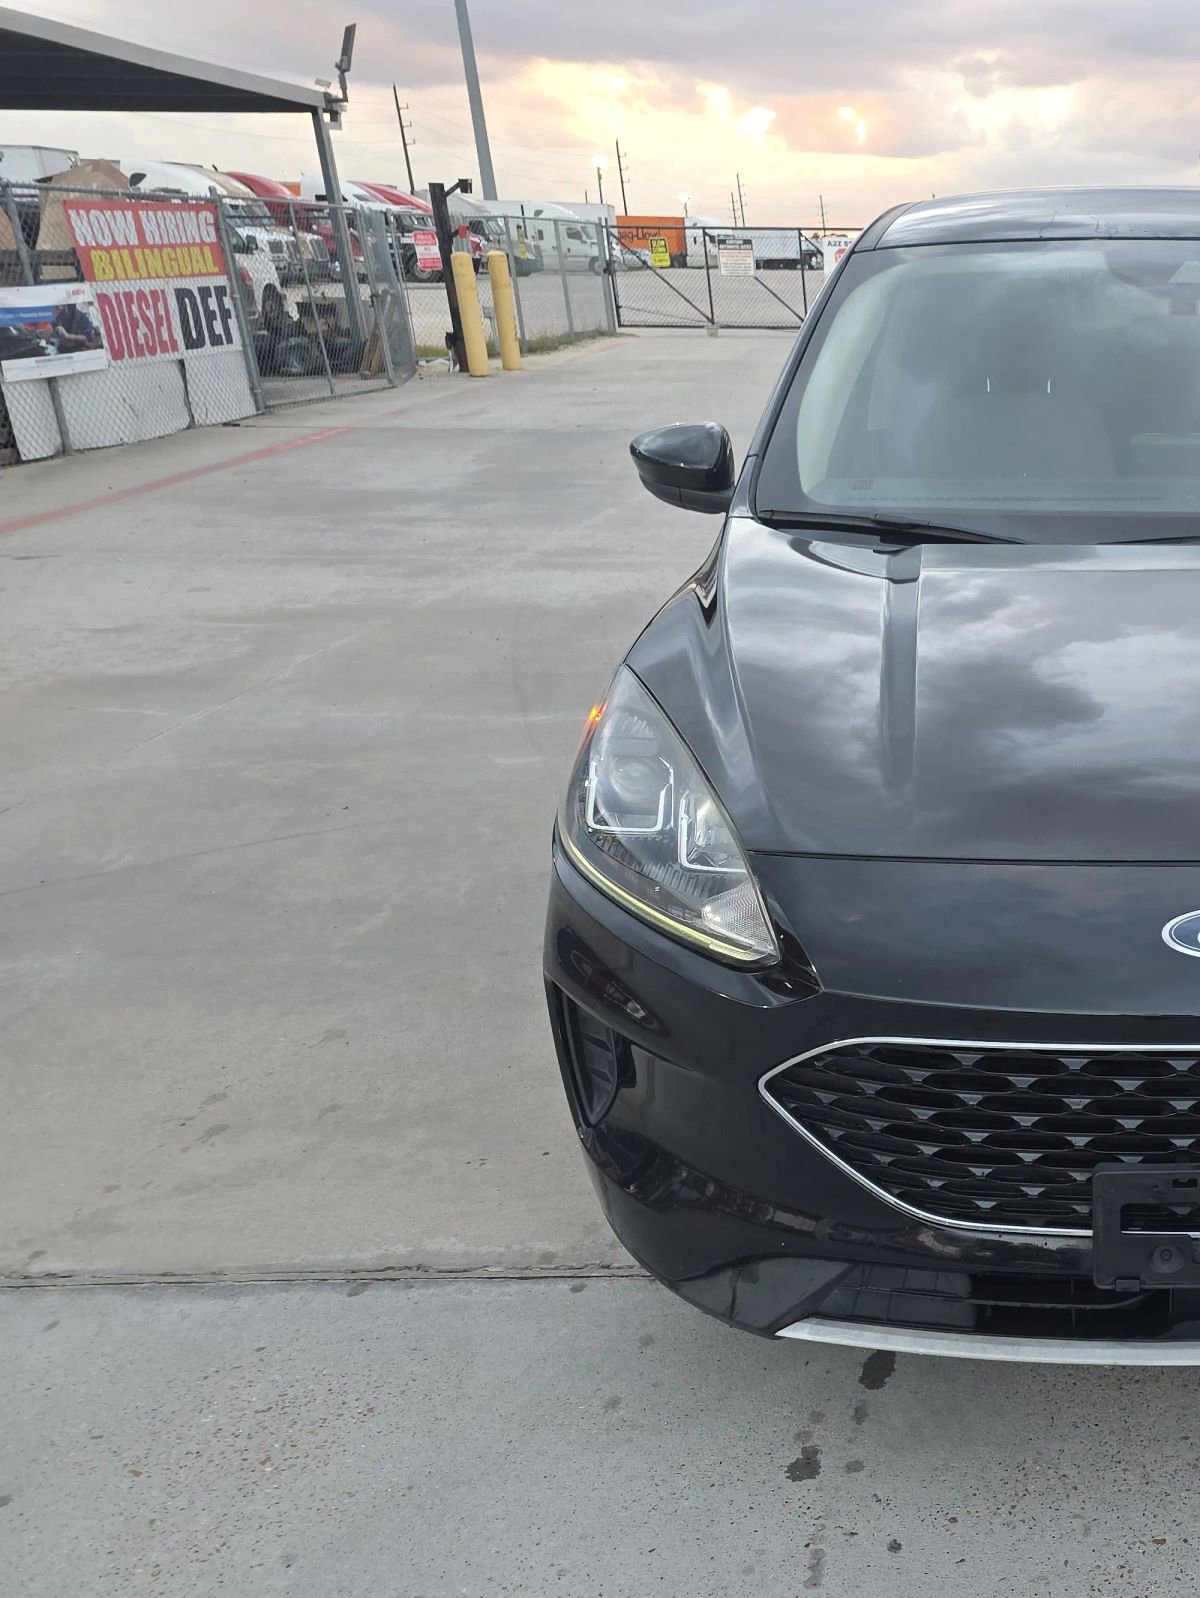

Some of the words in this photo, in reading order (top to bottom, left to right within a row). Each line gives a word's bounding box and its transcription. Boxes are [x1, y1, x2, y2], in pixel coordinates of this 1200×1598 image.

[68, 209, 139, 247] NOW
[139, 210, 217, 245] HIRING
[90, 246, 219, 281] BILINGUAL
[96, 289, 179, 361] DIESEL
[174, 285, 233, 350] DEF
